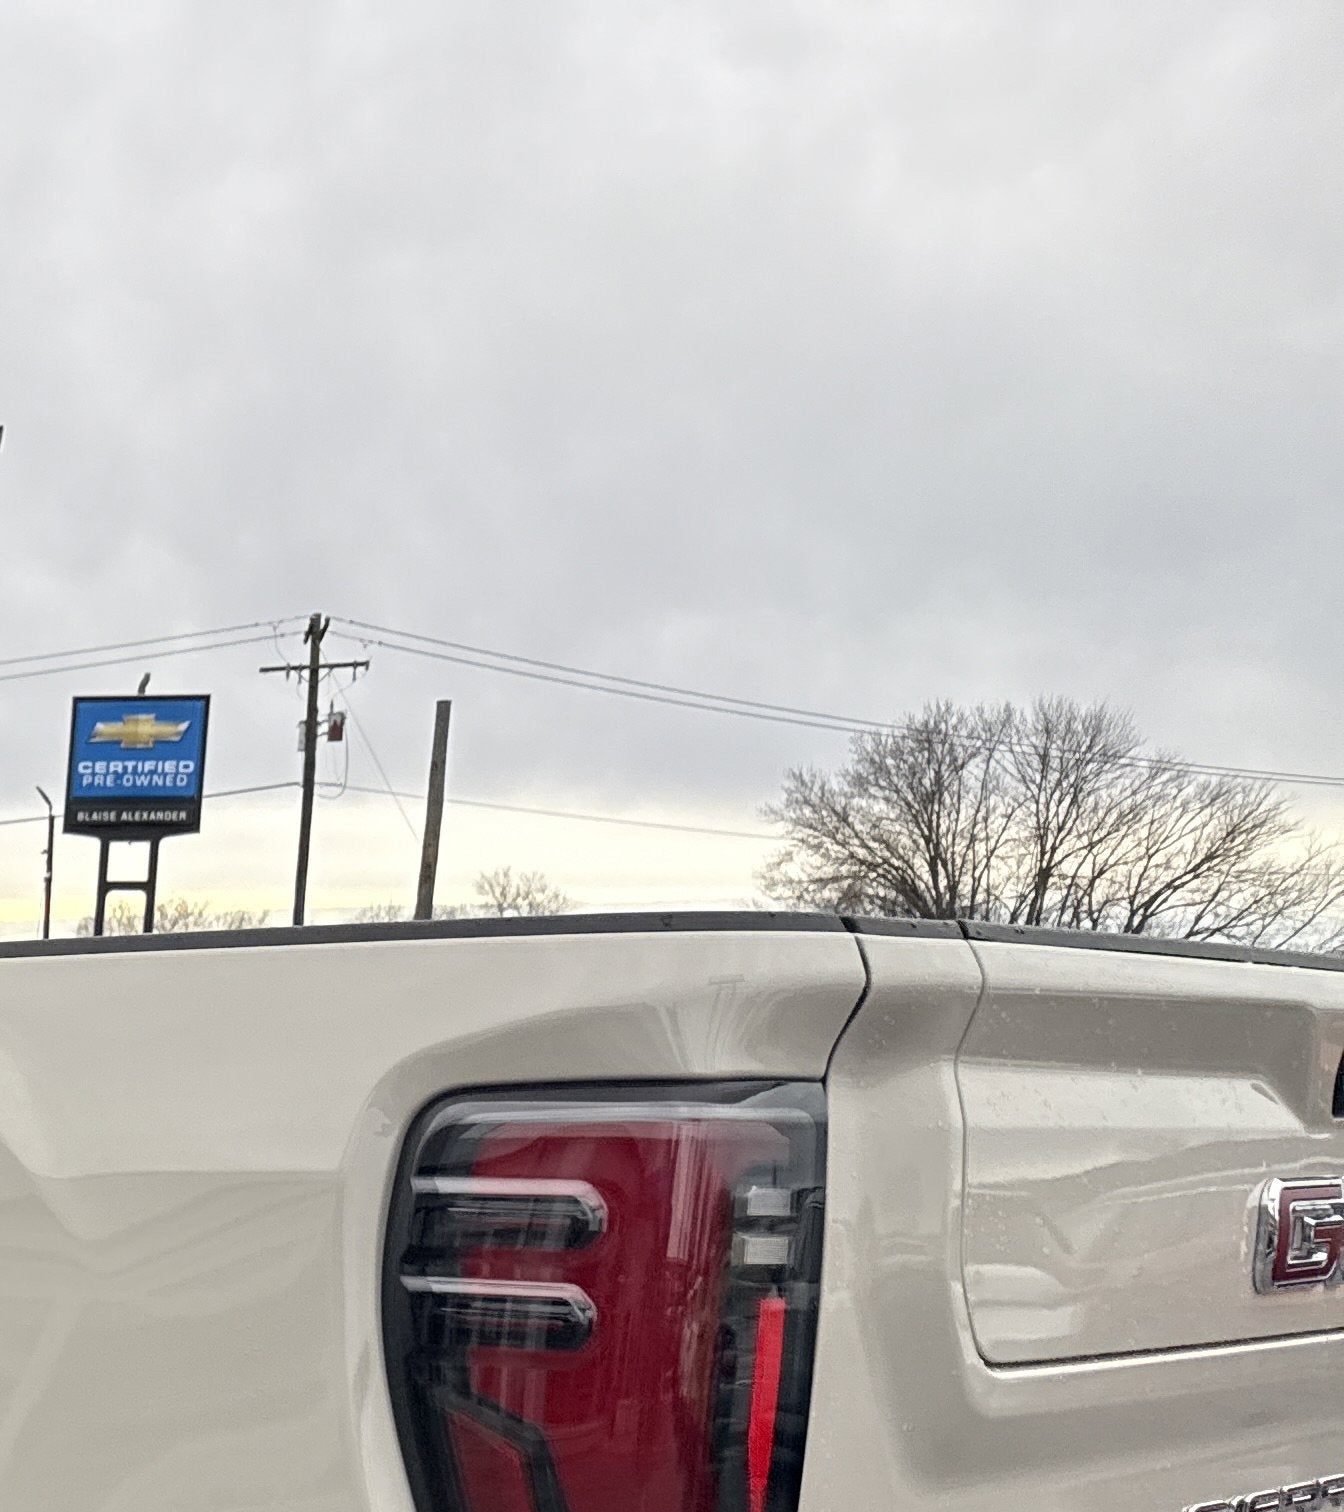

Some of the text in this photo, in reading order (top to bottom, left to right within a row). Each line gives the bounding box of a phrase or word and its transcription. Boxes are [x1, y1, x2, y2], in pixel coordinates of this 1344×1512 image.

[77, 760, 195, 774] CERTIFIED
[81, 774, 188, 788] PRE-OWNED
[76, 810, 187, 822] BLAISE ALEXANDER
[1268, 1176, 1344, 1288] G
